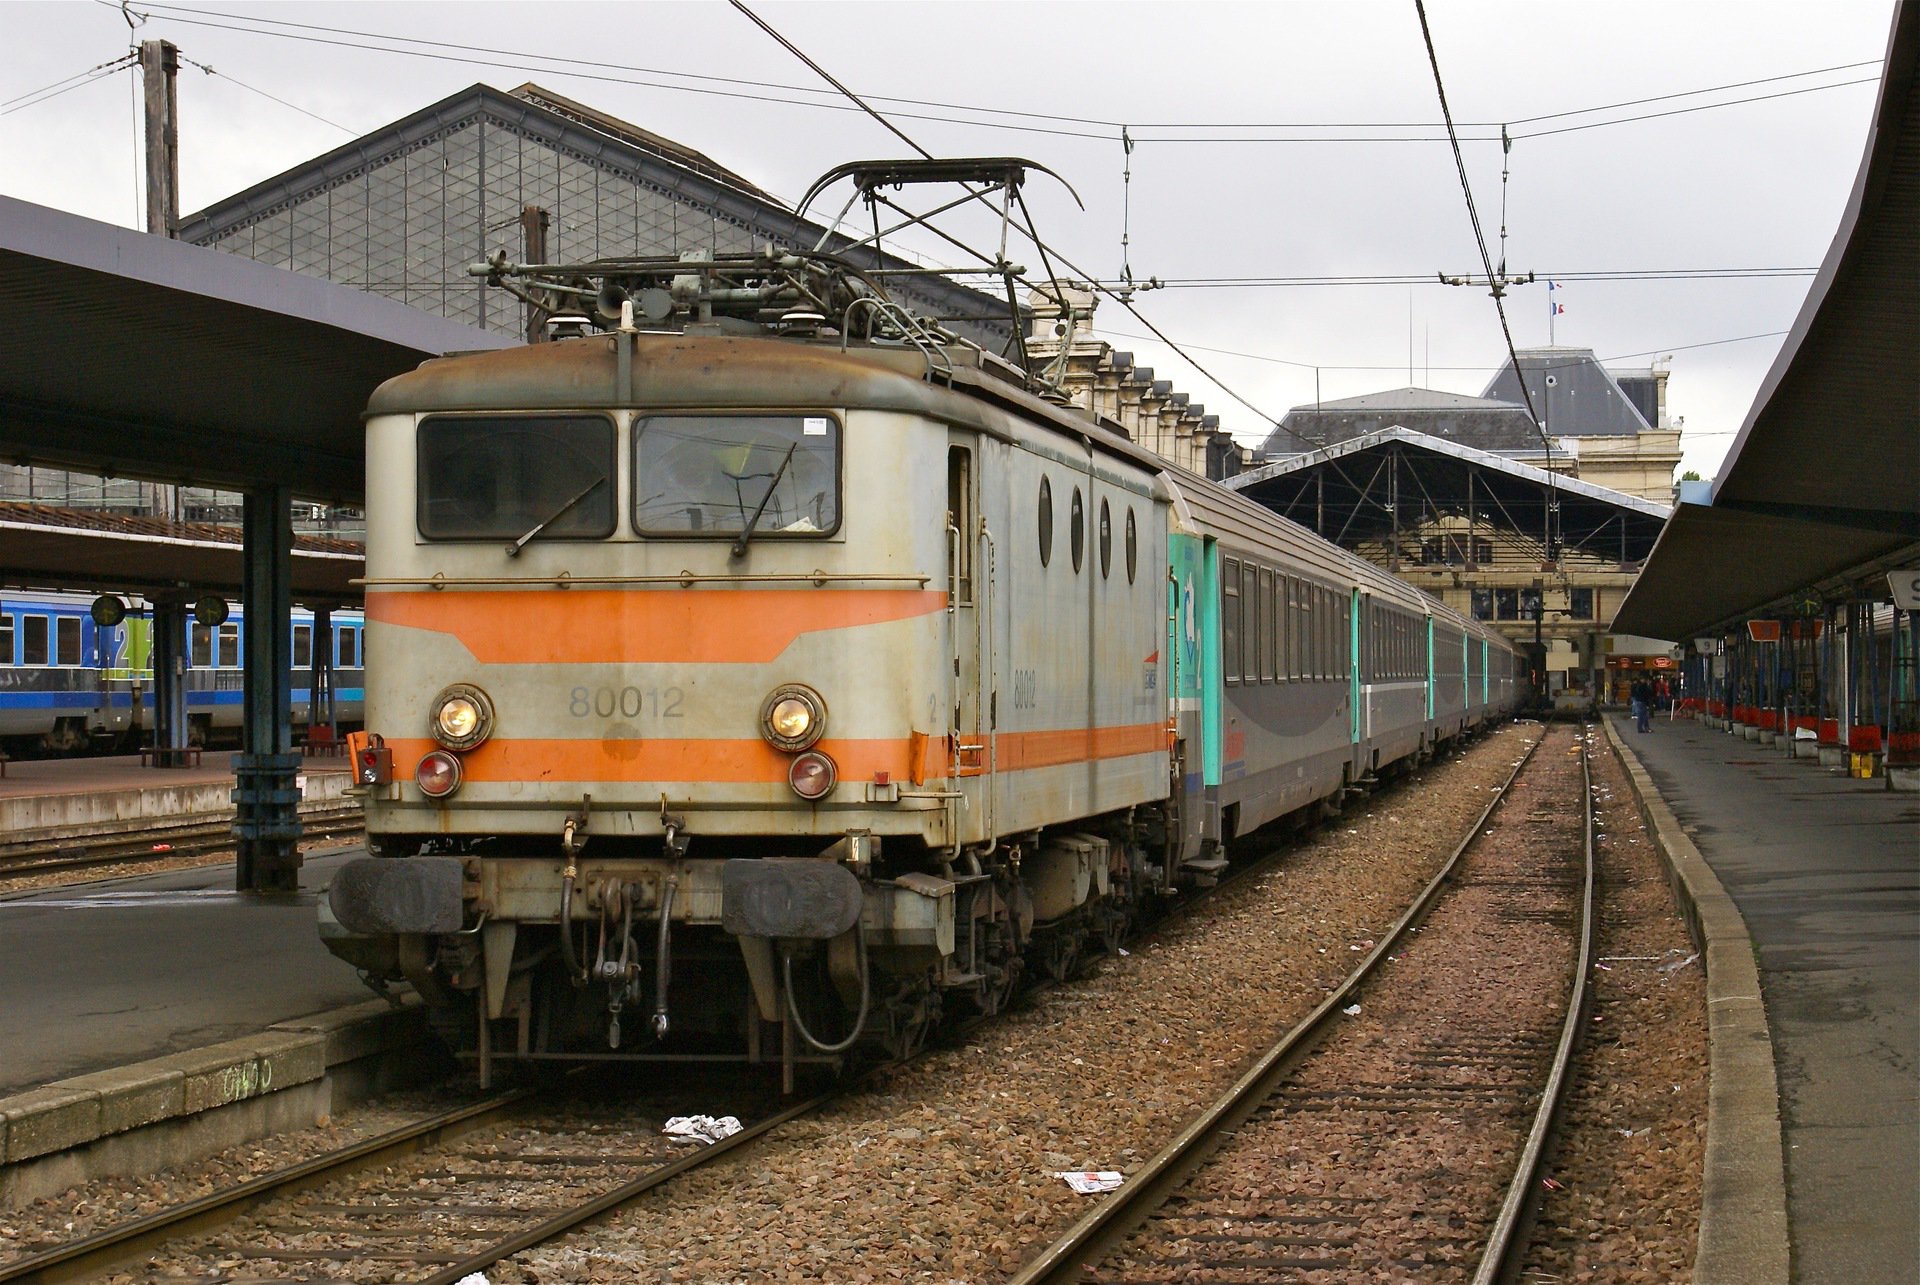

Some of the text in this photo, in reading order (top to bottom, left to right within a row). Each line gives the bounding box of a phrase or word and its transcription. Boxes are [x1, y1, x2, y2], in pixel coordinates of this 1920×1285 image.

[114, 617, 129, 669] 2
[569, 686, 684, 718] 80012
[1014, 669, 1036, 709] 80012
